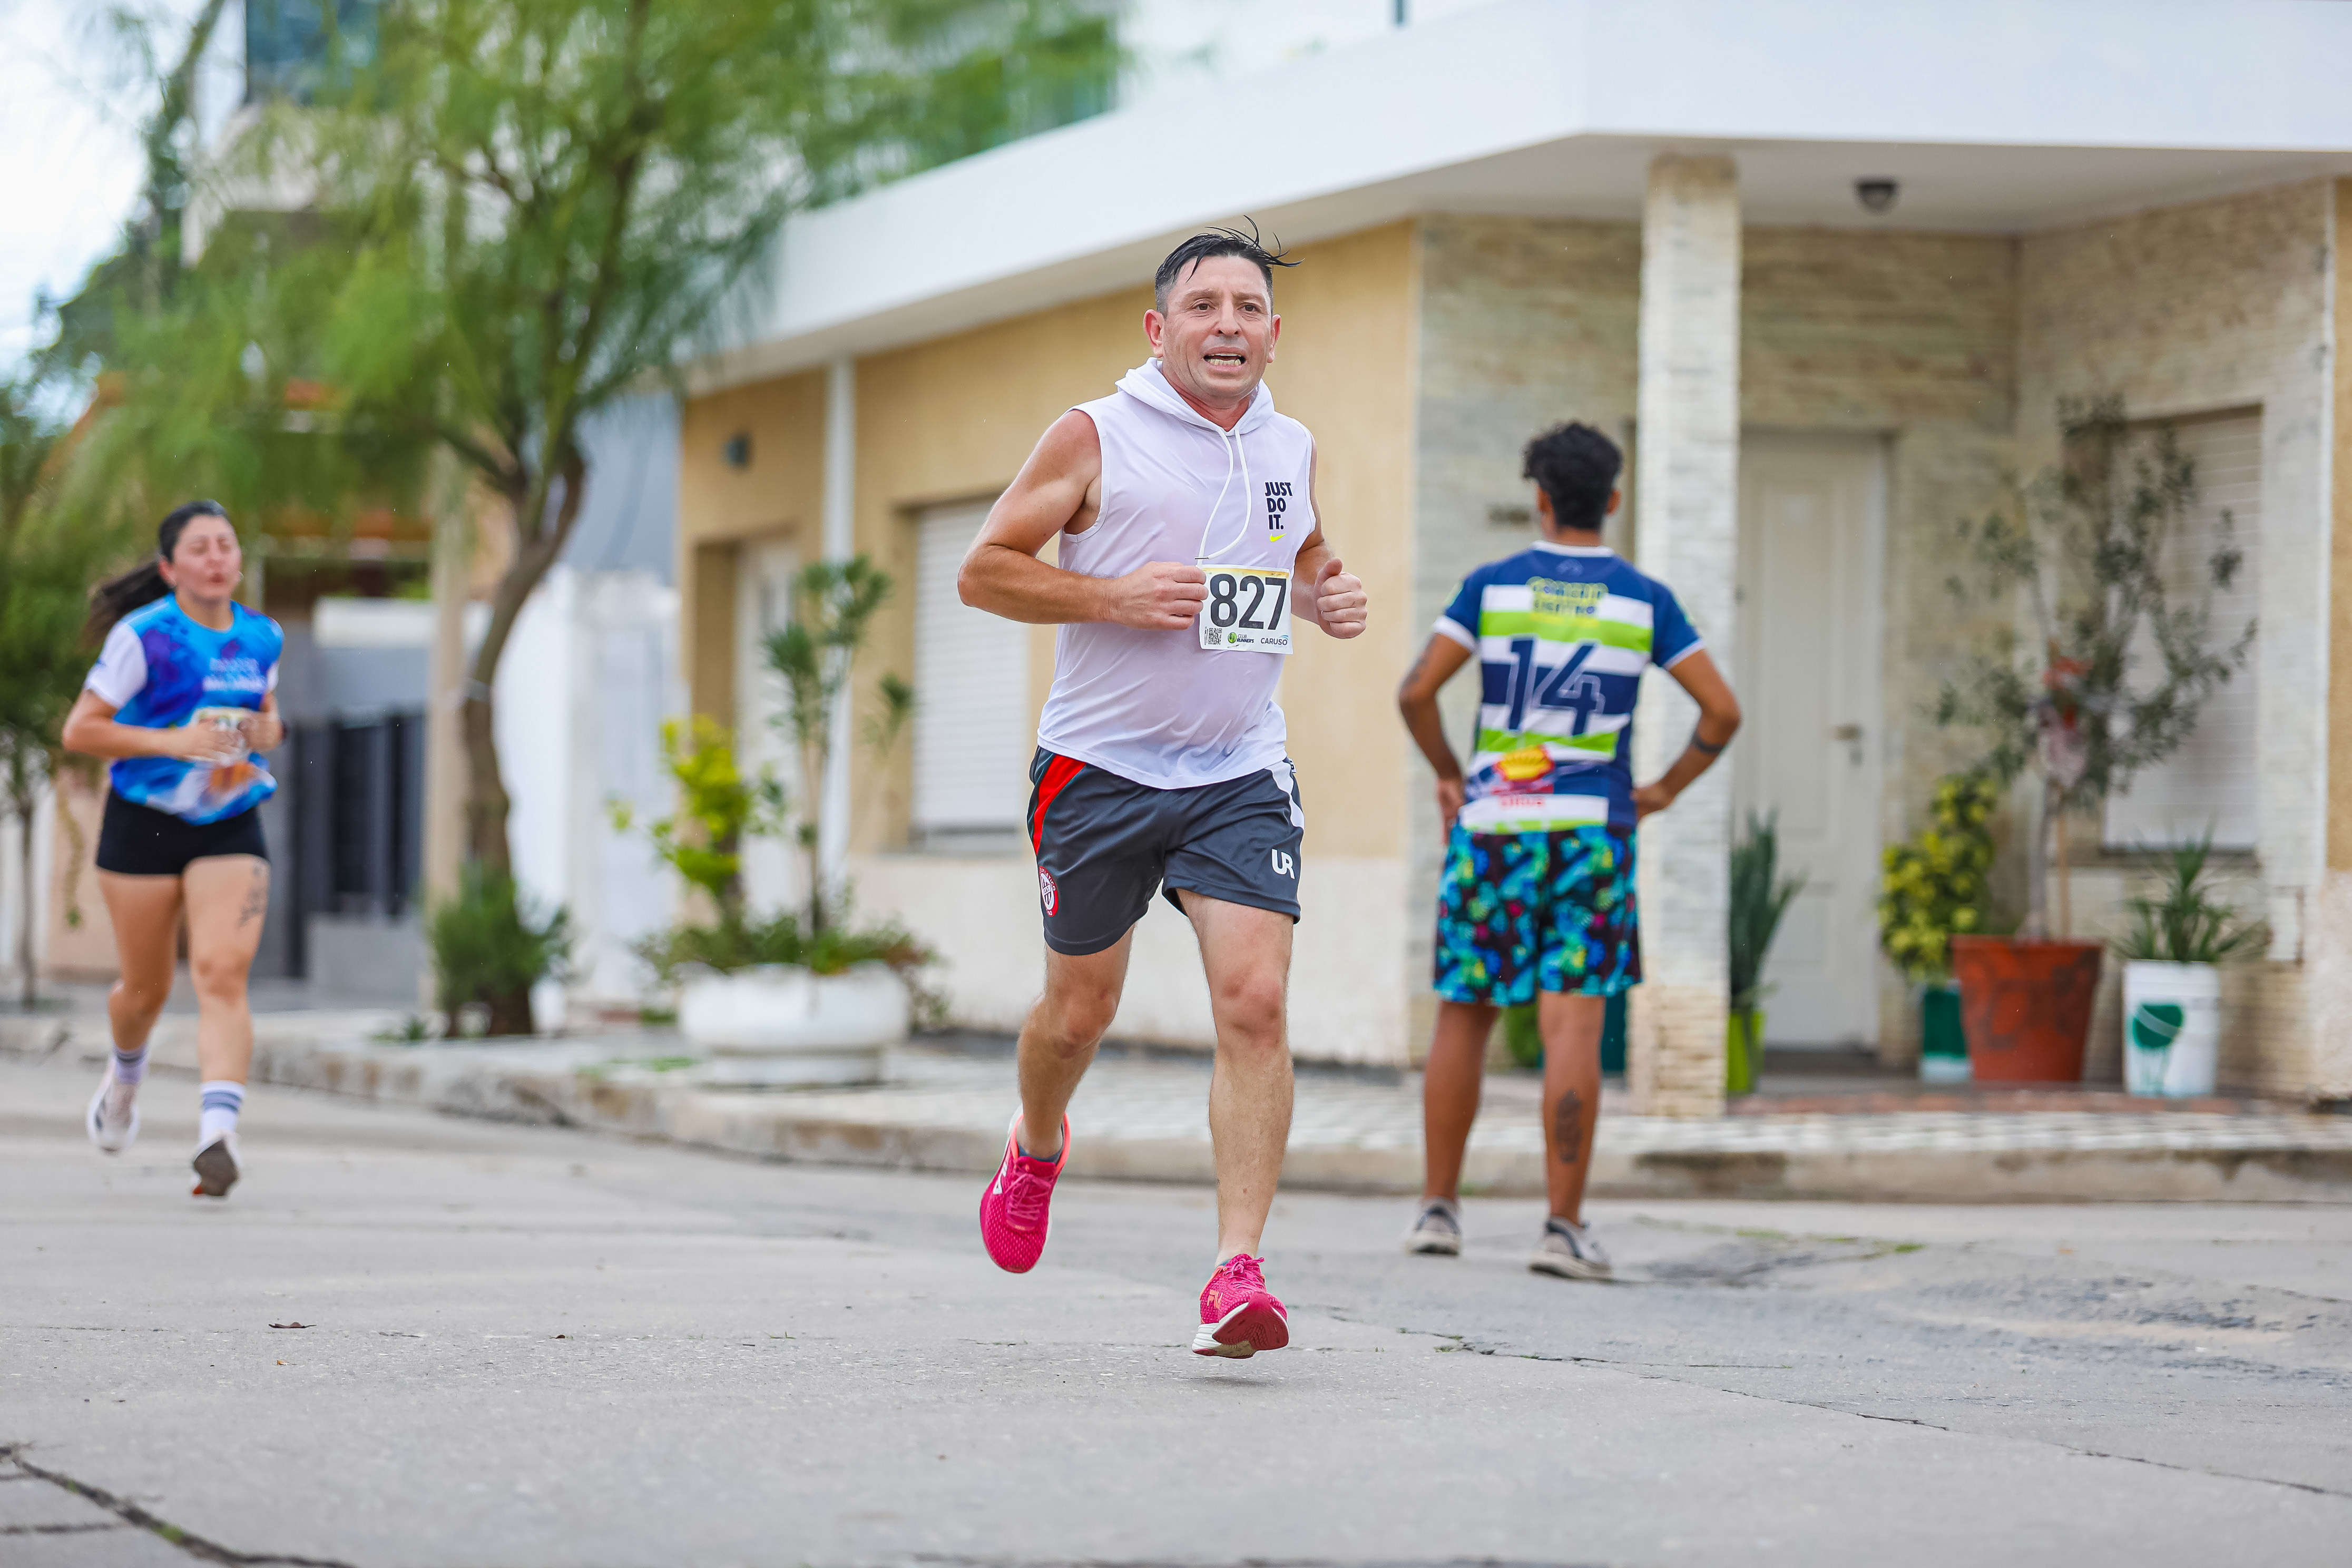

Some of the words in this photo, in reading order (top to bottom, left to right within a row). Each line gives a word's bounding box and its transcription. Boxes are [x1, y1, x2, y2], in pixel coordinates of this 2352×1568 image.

[1265, 482, 1292, 496] JUST
[1267, 497, 1286, 513] DO
[1268, 514, 1284, 530] IT.
[1210, 573, 1287, 631] 827
[1506, 636, 1605, 737] 14
